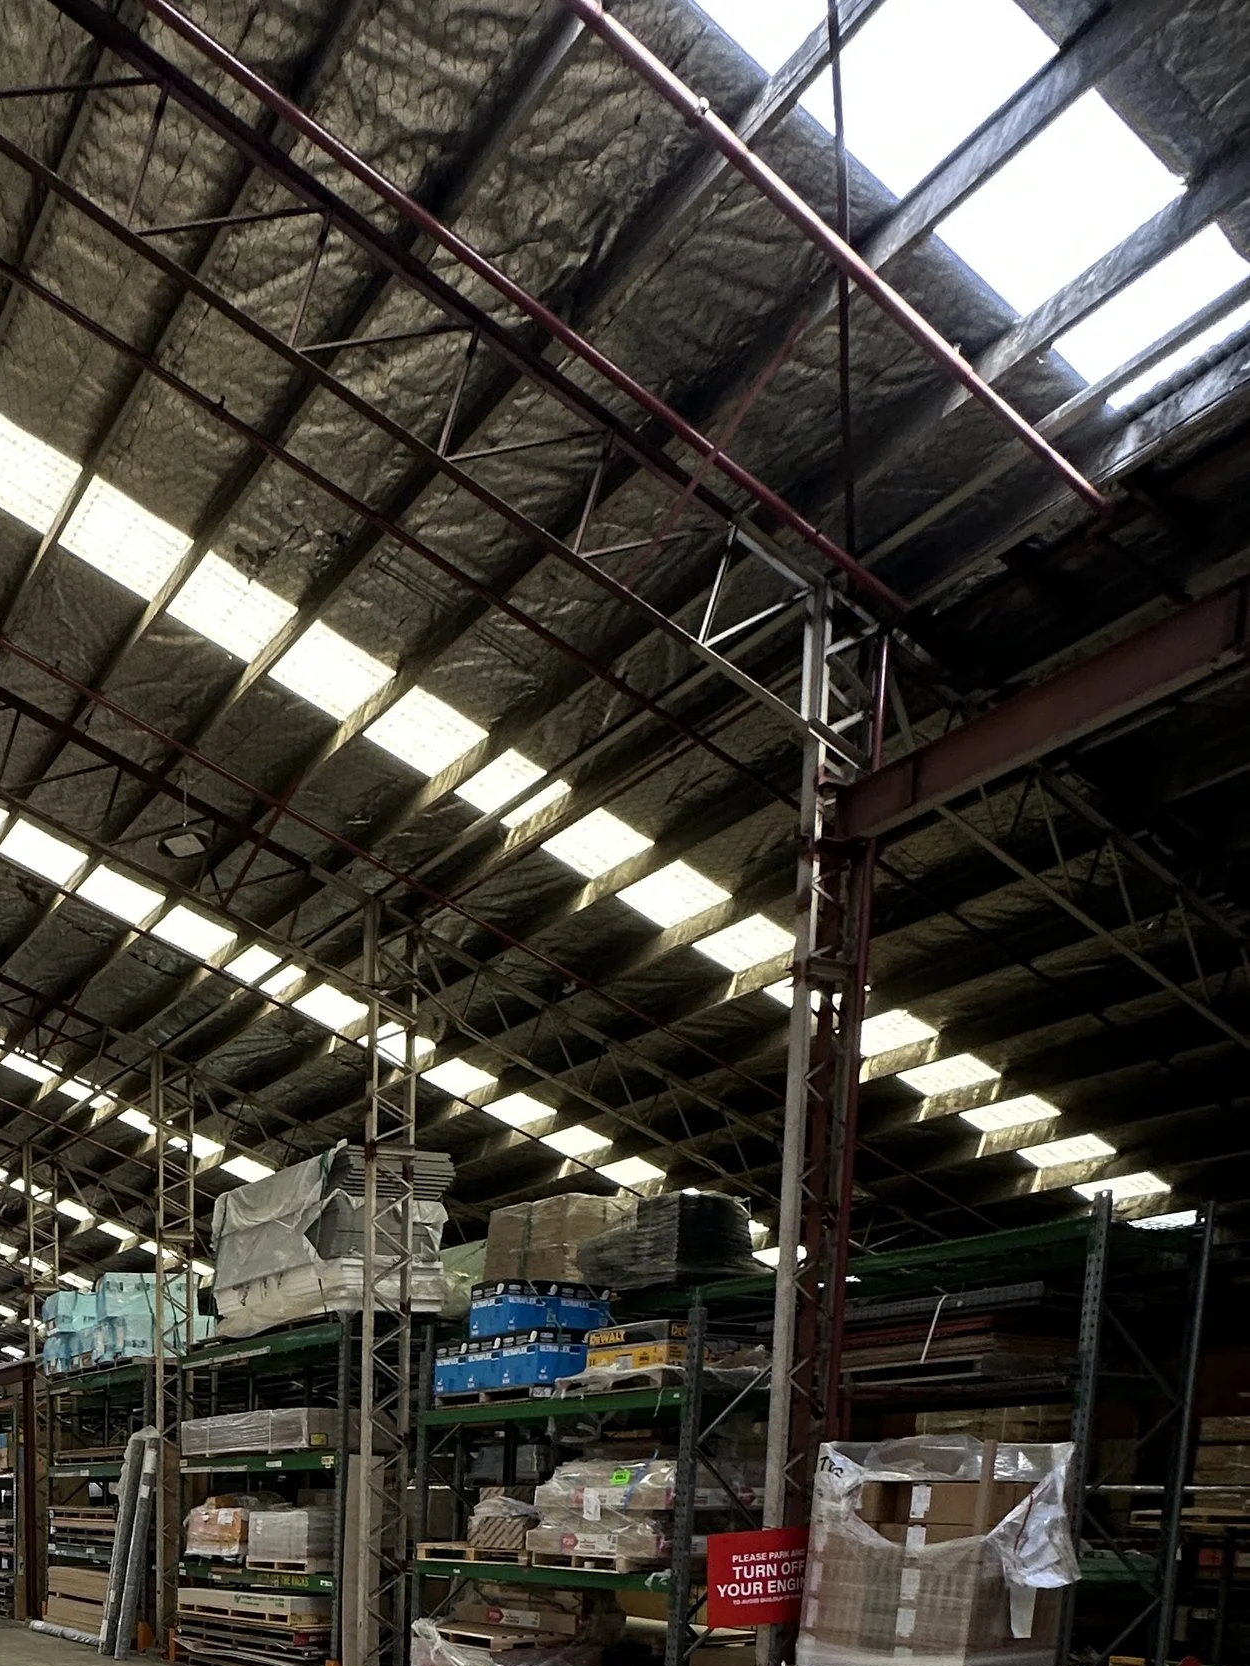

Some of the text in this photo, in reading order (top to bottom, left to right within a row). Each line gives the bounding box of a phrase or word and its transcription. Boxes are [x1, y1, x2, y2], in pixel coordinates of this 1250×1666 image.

[732, 1552, 767, 1563] PLEASE
[768, 1550, 790, 1560] PARK
[732, 1560, 805, 1580] TURN OFF
[716, 1581, 763, 1598] YOUR
